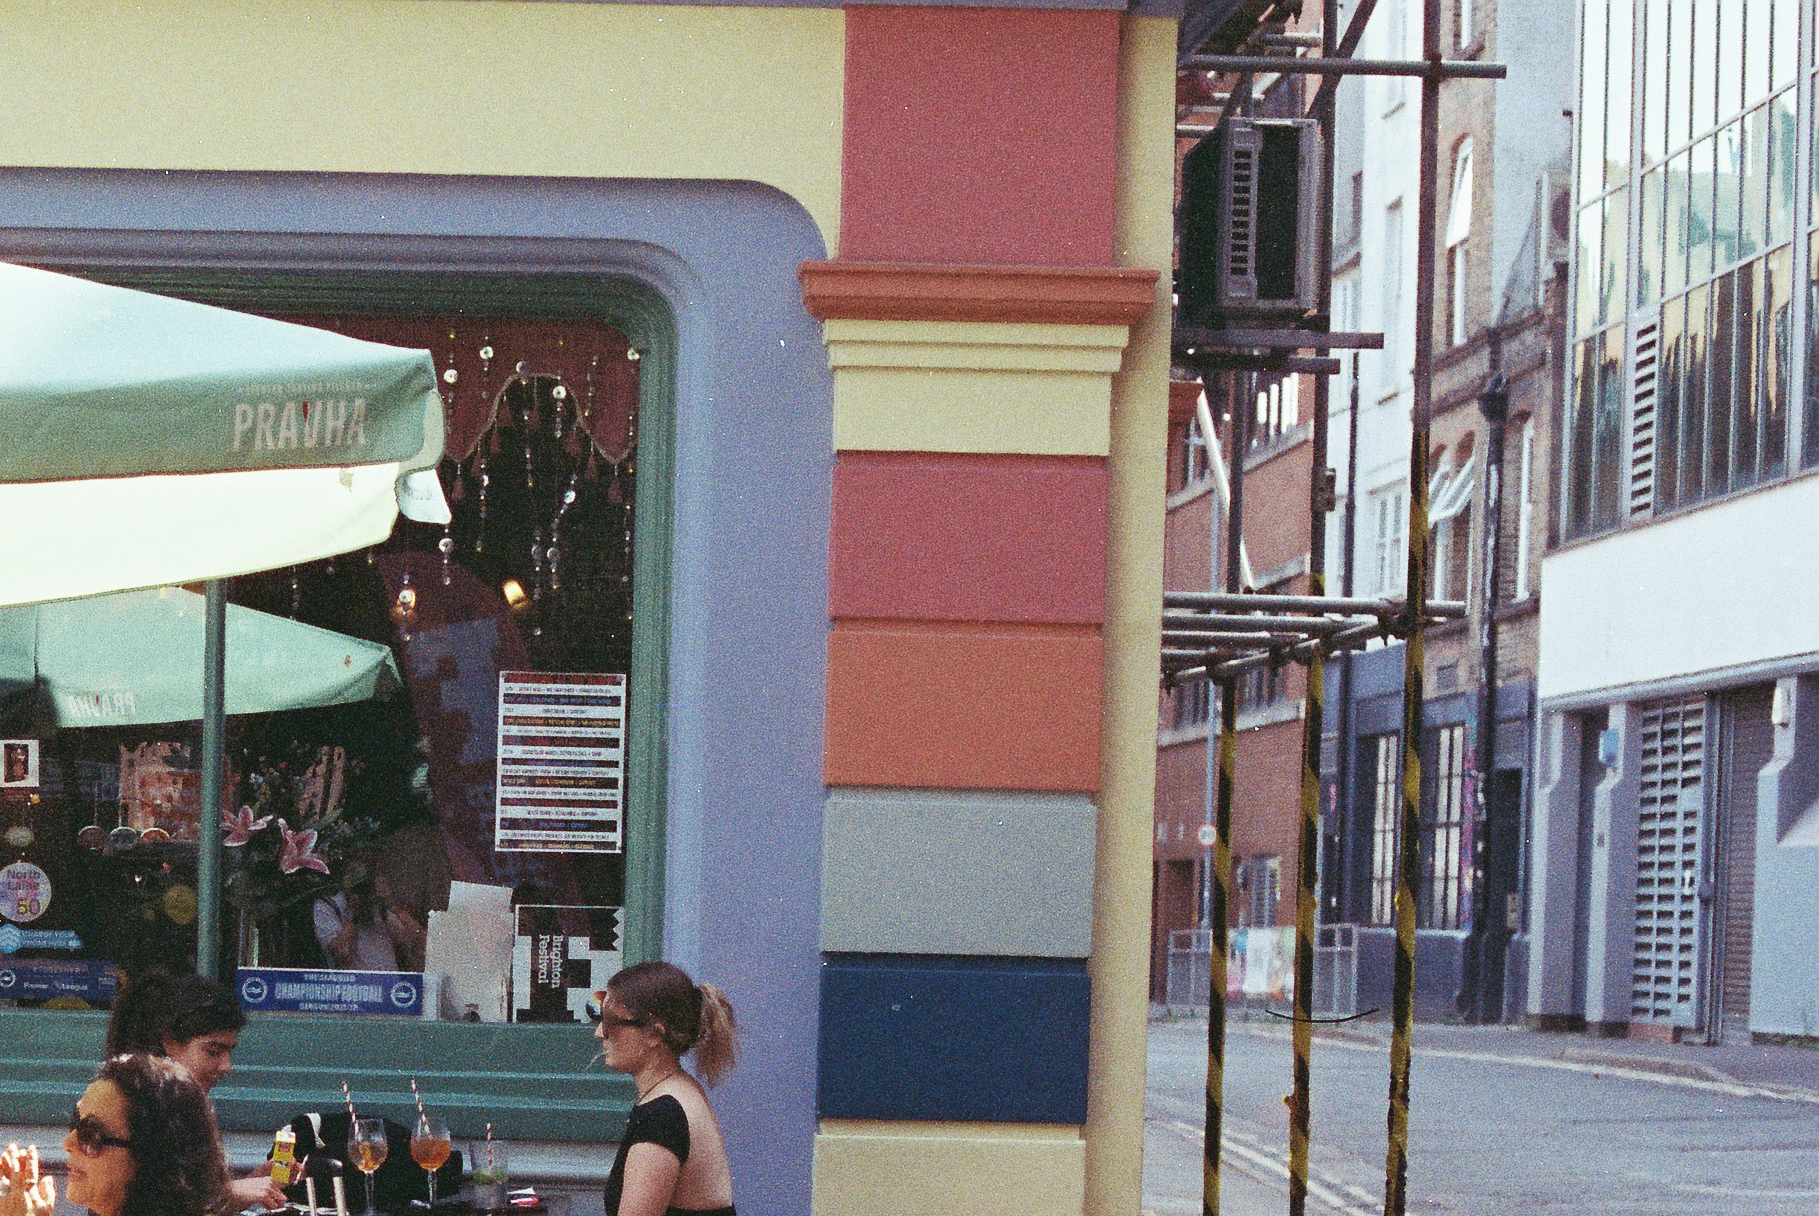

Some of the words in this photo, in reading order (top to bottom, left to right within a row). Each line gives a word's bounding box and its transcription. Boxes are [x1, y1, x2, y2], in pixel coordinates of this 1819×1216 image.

[232, 396, 368, 452] PRAVHA
[6, 869, 42, 879] North
[538, 934, 551, 984] Festival
[548, 934, 564, 989] Brighton
